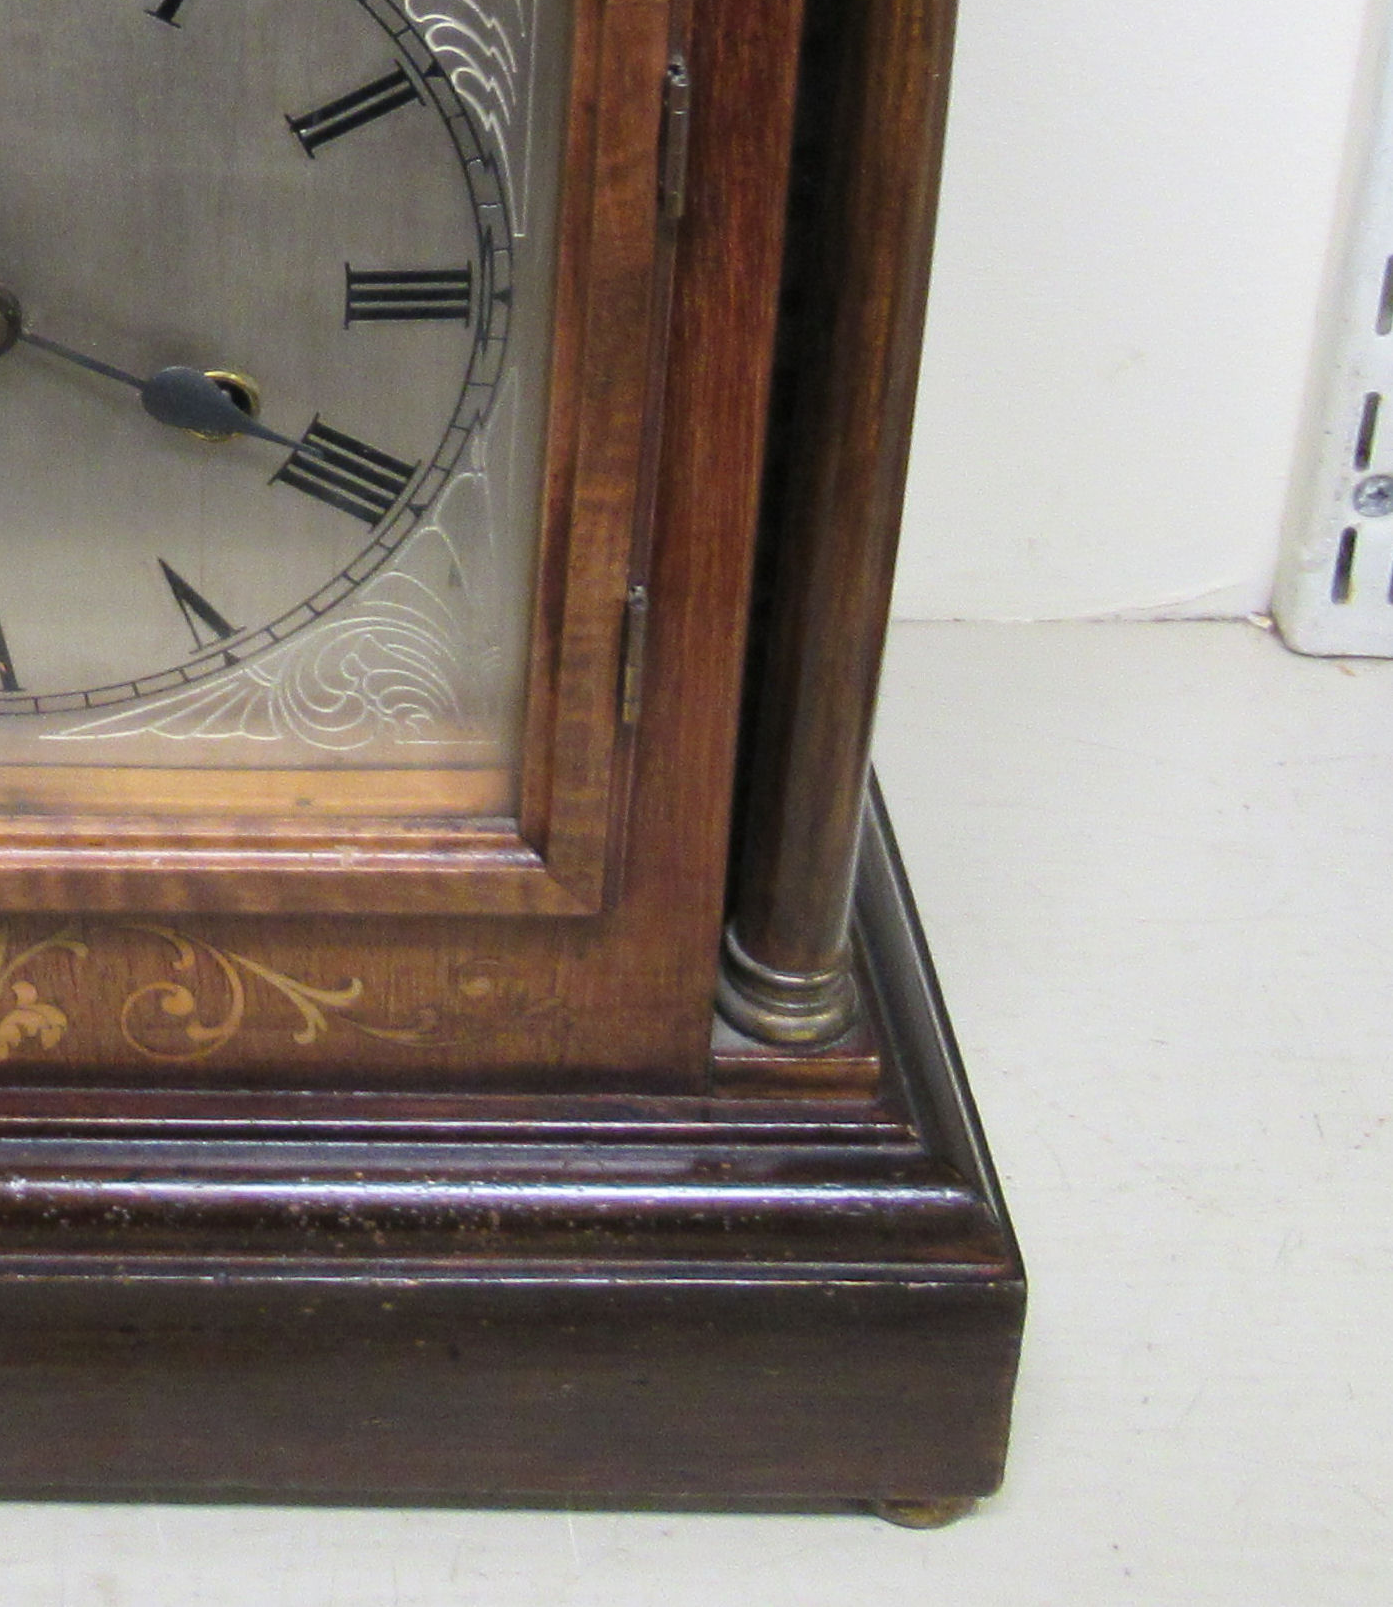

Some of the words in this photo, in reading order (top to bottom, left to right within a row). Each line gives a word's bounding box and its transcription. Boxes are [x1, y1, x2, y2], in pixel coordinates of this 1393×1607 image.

[283, 59, 428, 161] II
[344, 260, 473, 330] III
[269, 413, 422, 530] IIII
[155, 557, 248, 653] V
